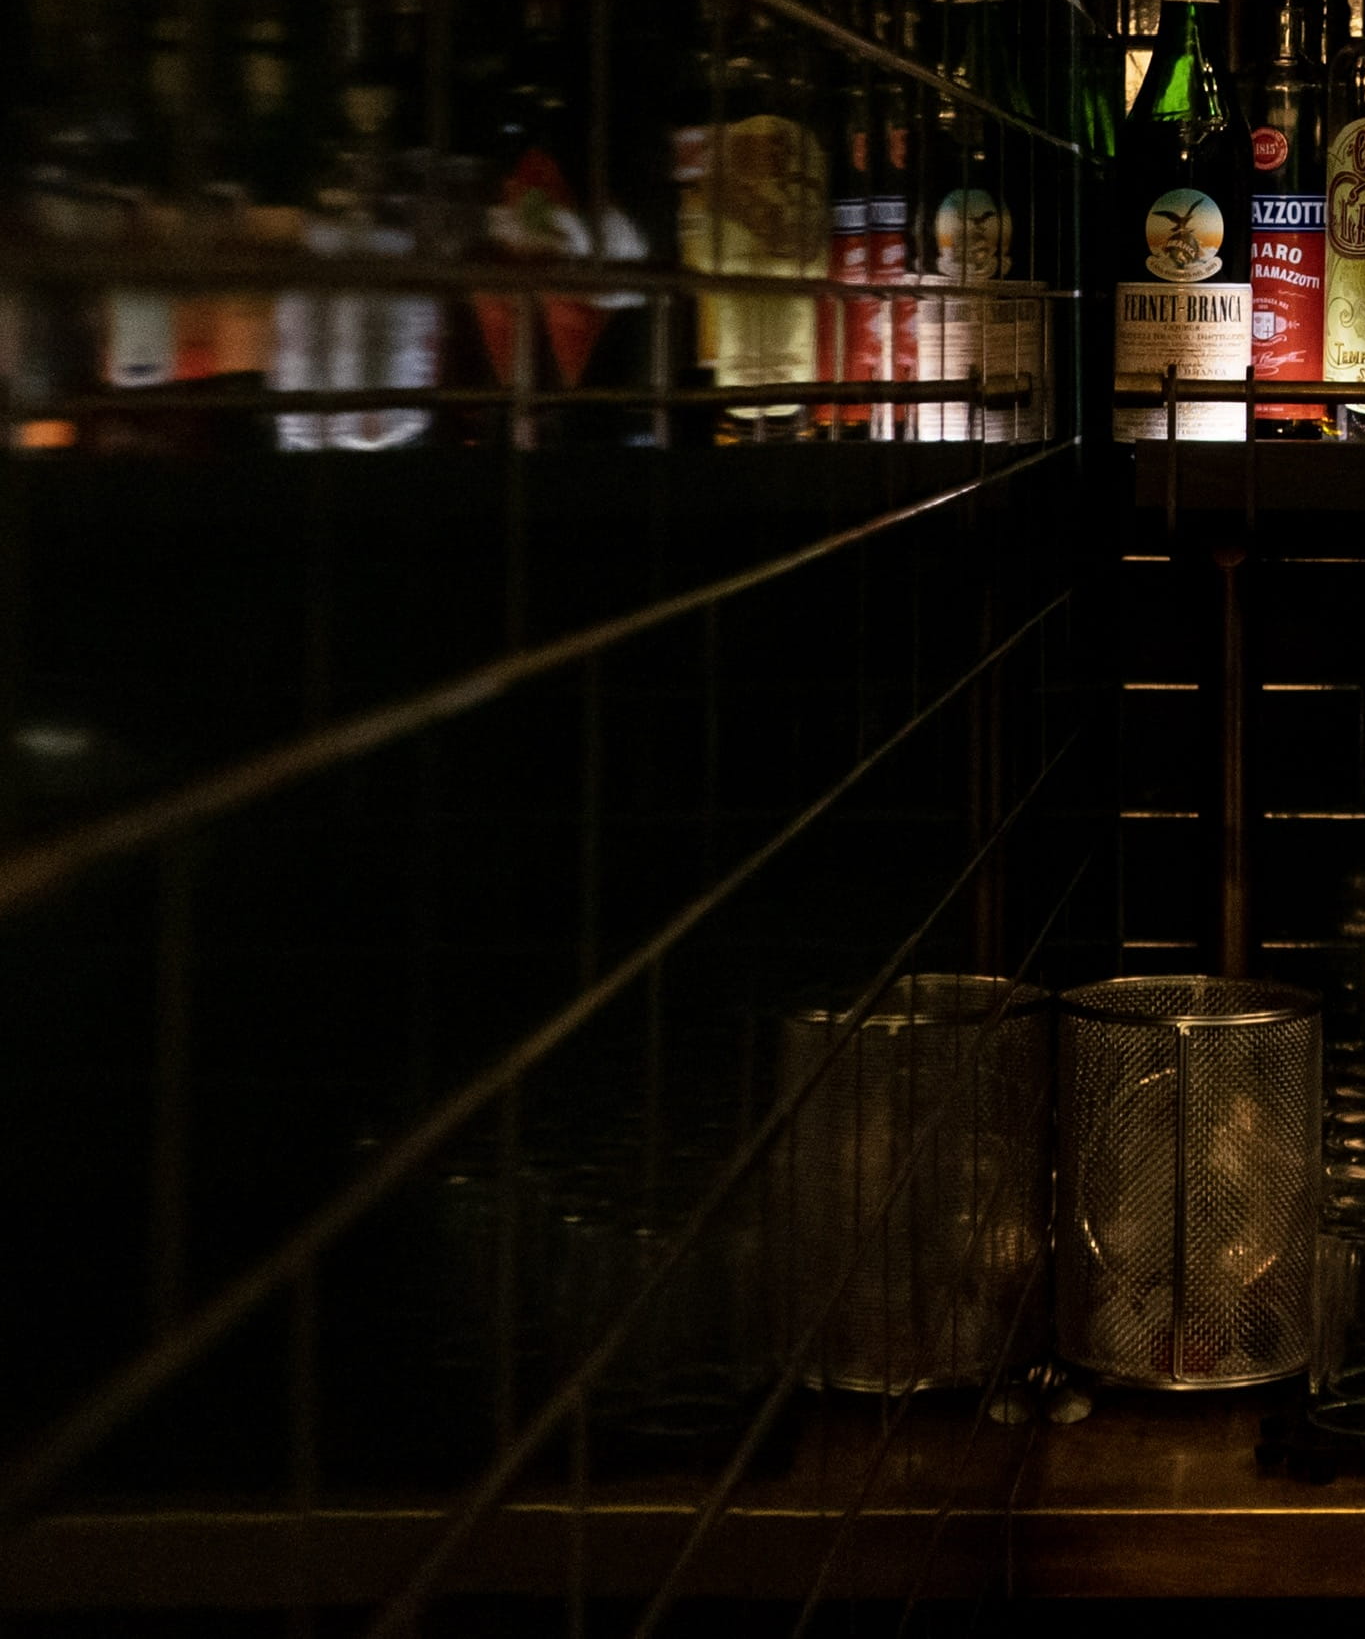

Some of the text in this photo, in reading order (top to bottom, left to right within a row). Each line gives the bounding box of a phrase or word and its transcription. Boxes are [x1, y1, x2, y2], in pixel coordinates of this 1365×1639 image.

[1255, 143, 1277, 155] 1815
[1256, 263, 1320, 289] RAMAZZOTTI
[1124, 293, 1243, 323] FERNET-BRANCA
